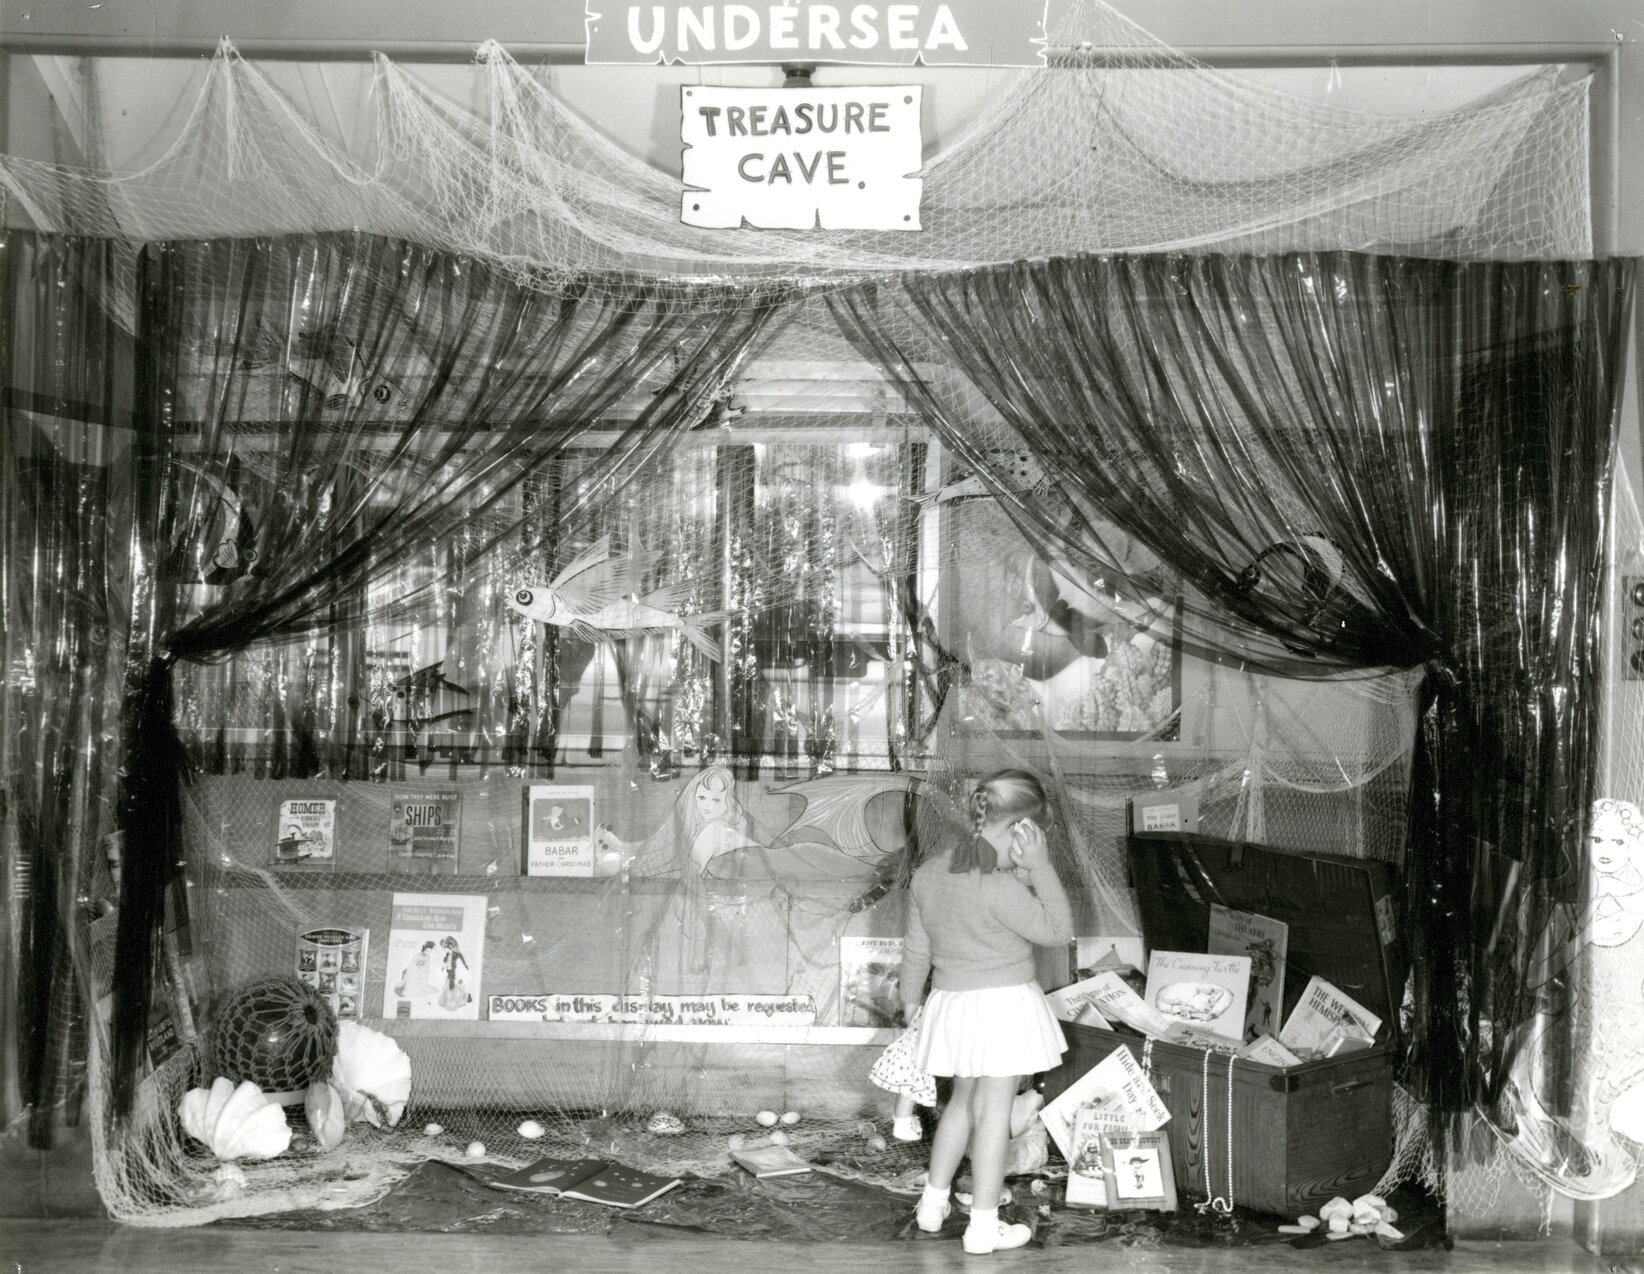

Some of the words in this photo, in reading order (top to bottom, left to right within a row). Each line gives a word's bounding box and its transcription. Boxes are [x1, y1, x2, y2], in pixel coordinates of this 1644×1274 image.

[628, 4, 968, 54] UNDERSEA
[699, 102, 891, 137] TREASURE
[737, 150, 866, 189] CAVE.
[405, 805, 442, 826] SHIPS
[545, 846, 579, 856] BABAR
[1312, 984, 1329, 1002] THE
[492, 997, 547, 1014] BOOKS
[556, 997, 570, 1012] in
[573, 997, 602, 1014] this
[680, 1001, 716, 1018] may
[722, 998, 740, 1012] be
[1116, 1048, 1135, 1077] Hide
[1122, 1081, 1137, 1104] Day
[1093, 1112, 1126, 1123] LITTLE
